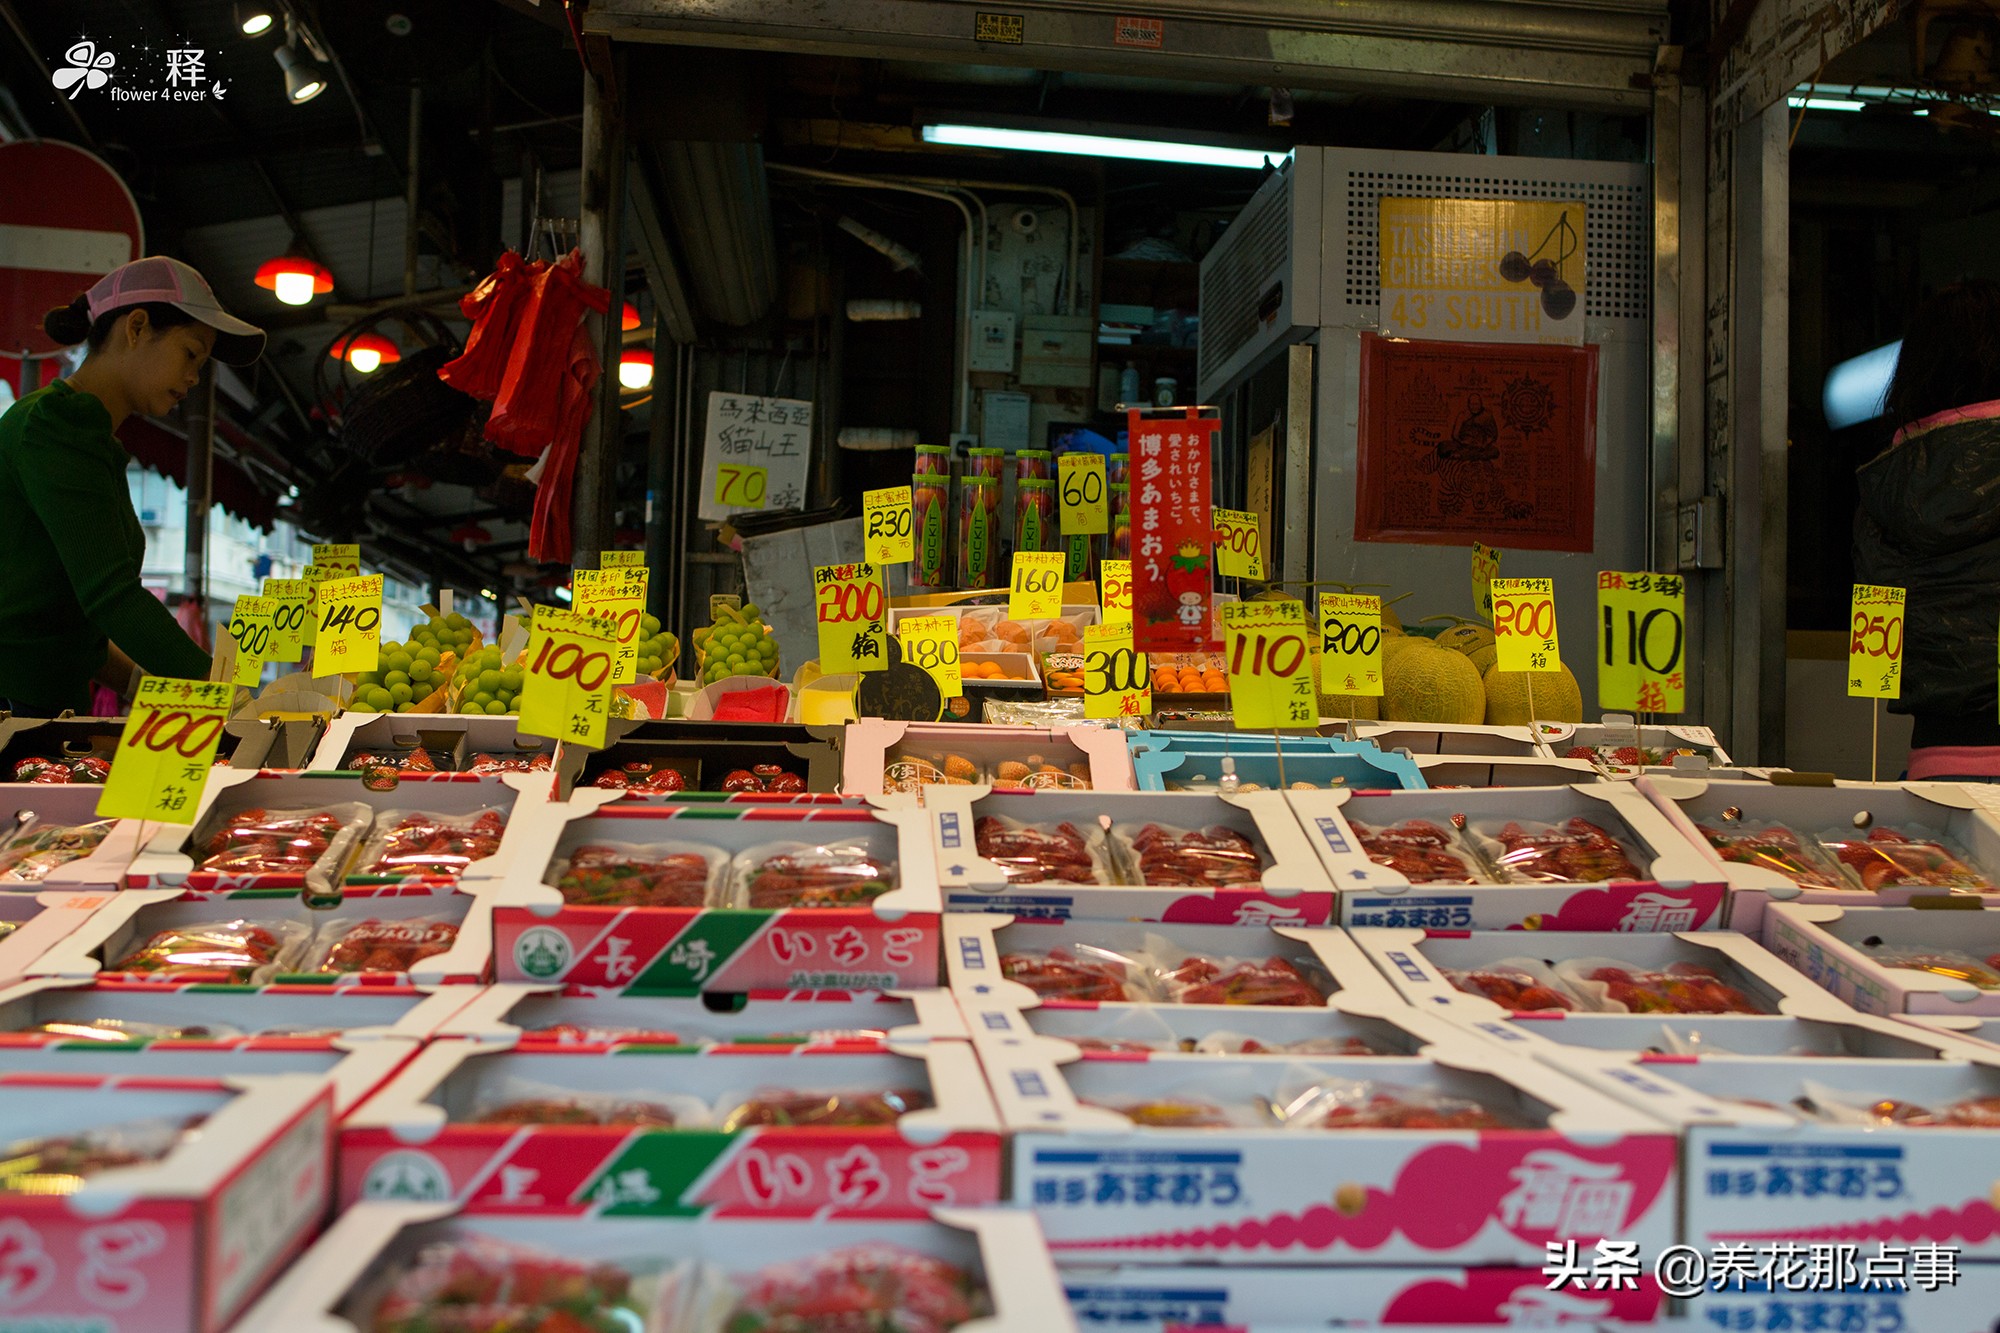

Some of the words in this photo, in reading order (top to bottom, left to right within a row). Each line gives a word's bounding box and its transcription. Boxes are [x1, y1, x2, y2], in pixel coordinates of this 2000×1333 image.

[1390, 226, 1529, 258] TASMANIAN
[1389, 257, 1501, 287] CHERRIES
[1446, 295, 1541, 332] SOUTH
[720, 398, 810, 427] 馬來西亞
[719, 424, 800, 457] 貓山王
[720, 469, 766, 502] 70
[1063, 470, 1102, 507] 60
[1095, 504, 1104, 514] 元
[868, 508, 912, 540] 230
[1026, 517, 1035, 552] CKIT
[898, 539, 910, 549] 元
[927, 513, 937, 571] ROCKIT
[972, 515, 982, 573] ROCKIT
[1215, 522, 1259, 557] 200
[1015, 568, 1060, 594] 160
[818, 581, 884, 623] 200
[1047, 595, 1060, 605] 元
[272, 603, 305, 632] 00
[319, 604, 380, 634] 140
[867, 620, 883, 634] 元
[1494, 599, 1554, 640] 200
[289, 630, 300, 644] 元
[329, 638, 348, 656] 箱
[359, 628, 376, 641] 元
[851, 632, 879, 660] 箱
[1323, 618, 1381, 657] 200
[1542, 639, 1556, 652] 元
[1603, 605, 1683, 675] 110
[1850, 611, 1902, 661] 250
[247, 654, 259, 670] 元
[531, 636, 611, 692] 100
[618, 646, 635, 659] 元
[907, 638, 959, 670] 180
[1231, 633, 1306, 678] 110
[1530, 652, 1547, 669] 箱
[945, 669, 959, 681] 元
[1085, 648, 1150, 696] 300
[1343, 673, 1360, 690] 盒
[1365, 670, 1379, 683] 元
[1665, 672, 1683, 691] 元
[1889, 661, 1899, 675] 元
[1292, 677, 1312, 695] 元
[1635, 678, 1667, 713] 箱
[585, 693, 602, 714] 元
[1118, 694, 1140, 716] 箱
[1289, 700, 1310, 721] 箱
[127, 710, 225, 758] 100
[571, 713, 591, 737] 箱
[181, 763, 205, 782] 元
[156, 785, 188, 811] 箱
[594, 936, 716, 983] 長崎
[767, 926, 924, 968] いちご
[737, 1146, 969, 1211] いちご
